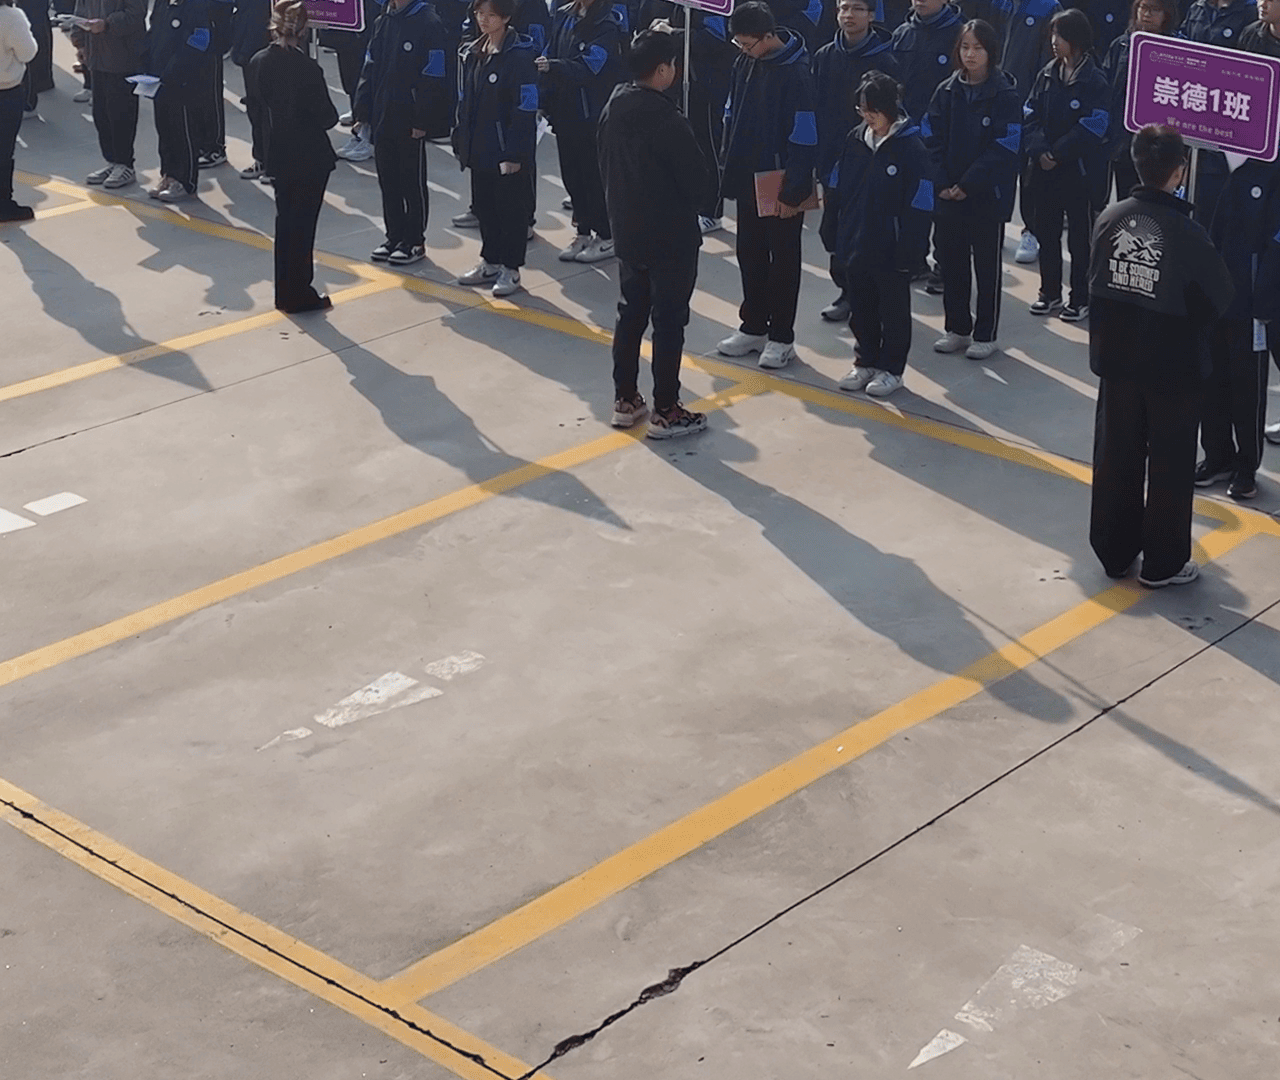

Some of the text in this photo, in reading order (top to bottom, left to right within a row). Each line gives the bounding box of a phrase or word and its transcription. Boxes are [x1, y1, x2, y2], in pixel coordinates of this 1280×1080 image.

[1152, 75, 1252, 122] 崇德1班
[1166, 116, 1233, 138] We are the best
[1112, 272, 1129, 286] AND
